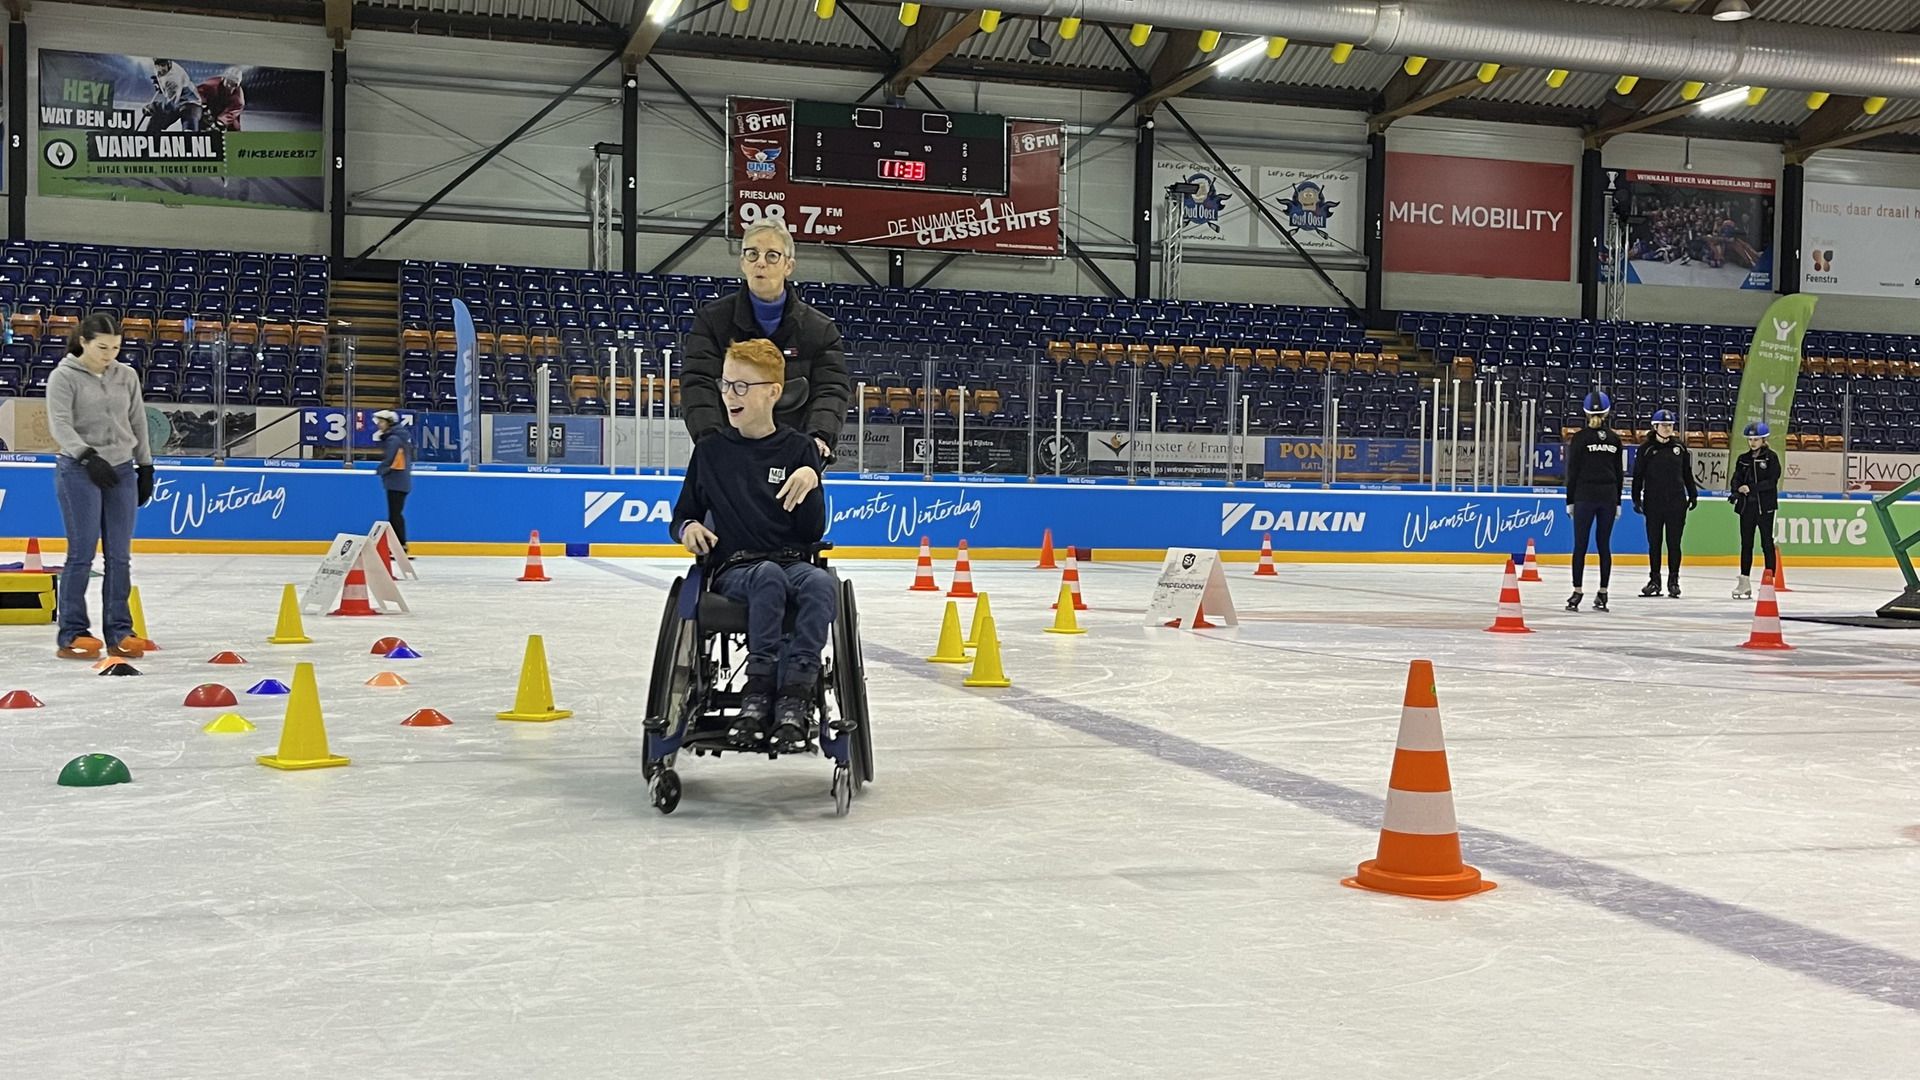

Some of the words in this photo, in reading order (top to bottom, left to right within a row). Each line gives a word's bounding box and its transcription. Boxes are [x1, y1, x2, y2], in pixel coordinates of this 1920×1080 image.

[63, 78, 110, 106] HEY!
[41, 106, 72, 126] WAT
[76, 109, 105, 128] BEN
[108, 111, 132, 130] JIJ
[13, 135, 20, 148] 3
[96, 136, 217, 158] VANPLAN.NL
[873, 141, 881, 149] 10
[237, 148, 318, 160] #IKBENERBIJ
[97, 165, 120, 174] UITJE
[161, 165, 188, 174] TICKET
[192, 165, 218, 174] KOPEN
[335, 157, 343, 169] 3
[748, 162, 775, 172] UNIS
[883, 160, 924, 179] 11:33
[628, 176, 635, 189] 2
[1637, 174, 1669, 182] WINNAAR
[1674, 176, 1696, 184] BEKER
[1711, 179, 1750, 188] NEDERLAND
[740, 190, 785, 201] FRIESLAND
[1199, 204, 1215, 219] Oost
[1809, 198, 1842, 216] Thuis,
[1846, 201, 1872, 216] daar
[740, 202, 821, 234] 98.7
[826, 208, 843, 217] FM
[888, 219, 908, 235] DE
[911, 207, 977, 231] NUMMER
[980, 198, 995, 220] 1
[1000, 202, 1016, 217] IN
[1144, 210, 1150, 222] 2
[1308, 211, 1324, 226] Oost
[1389, 201, 1444, 225] MHC
[1452, 205, 1563, 232] MOBILITY
[815, 224, 842, 235] DAB+
[917, 218, 1000, 245] CLASSIC
[1006, 210, 1051, 231] HITS
[895, 255, 902, 266] 2
[1806, 273, 1838, 284] Feenstra
[325, 413, 347, 441] 3
[863, 430, 890, 442] Bam
[170, 475, 286, 535] Winterdag
[888, 489, 981, 543] Winterdag
[1251, 510, 1365, 532] DAIKIN
[1403, 502, 1480, 548] Warmste
[1474, 500, 1554, 549] Winterdag
[1774, 508, 1867, 545] univé
[1158, 582, 1204, 590] HINDELOOPEN
